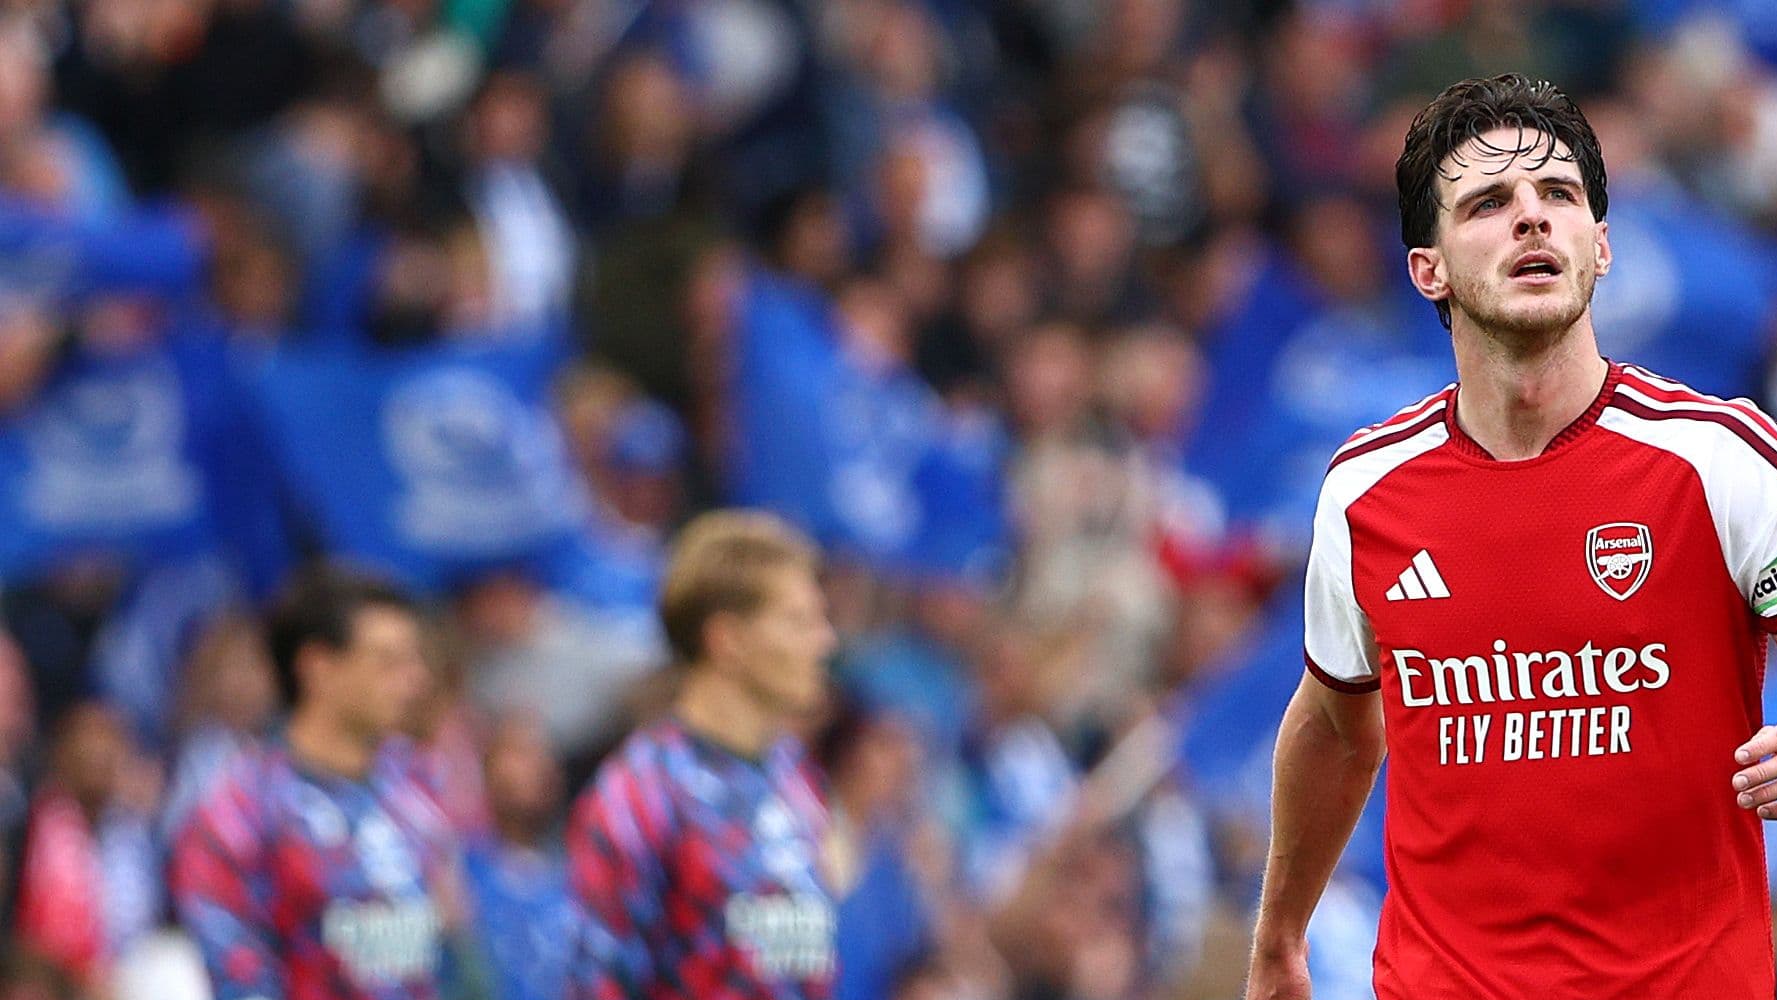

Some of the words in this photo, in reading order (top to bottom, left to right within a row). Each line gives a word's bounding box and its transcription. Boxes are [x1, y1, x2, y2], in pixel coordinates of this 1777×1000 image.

[1595, 534, 1641, 550] Arsenal
[1392, 639, 1671, 708] Emirates
[1440, 714, 1492, 765] FLY
[1503, 705, 1632, 762] BETTER
